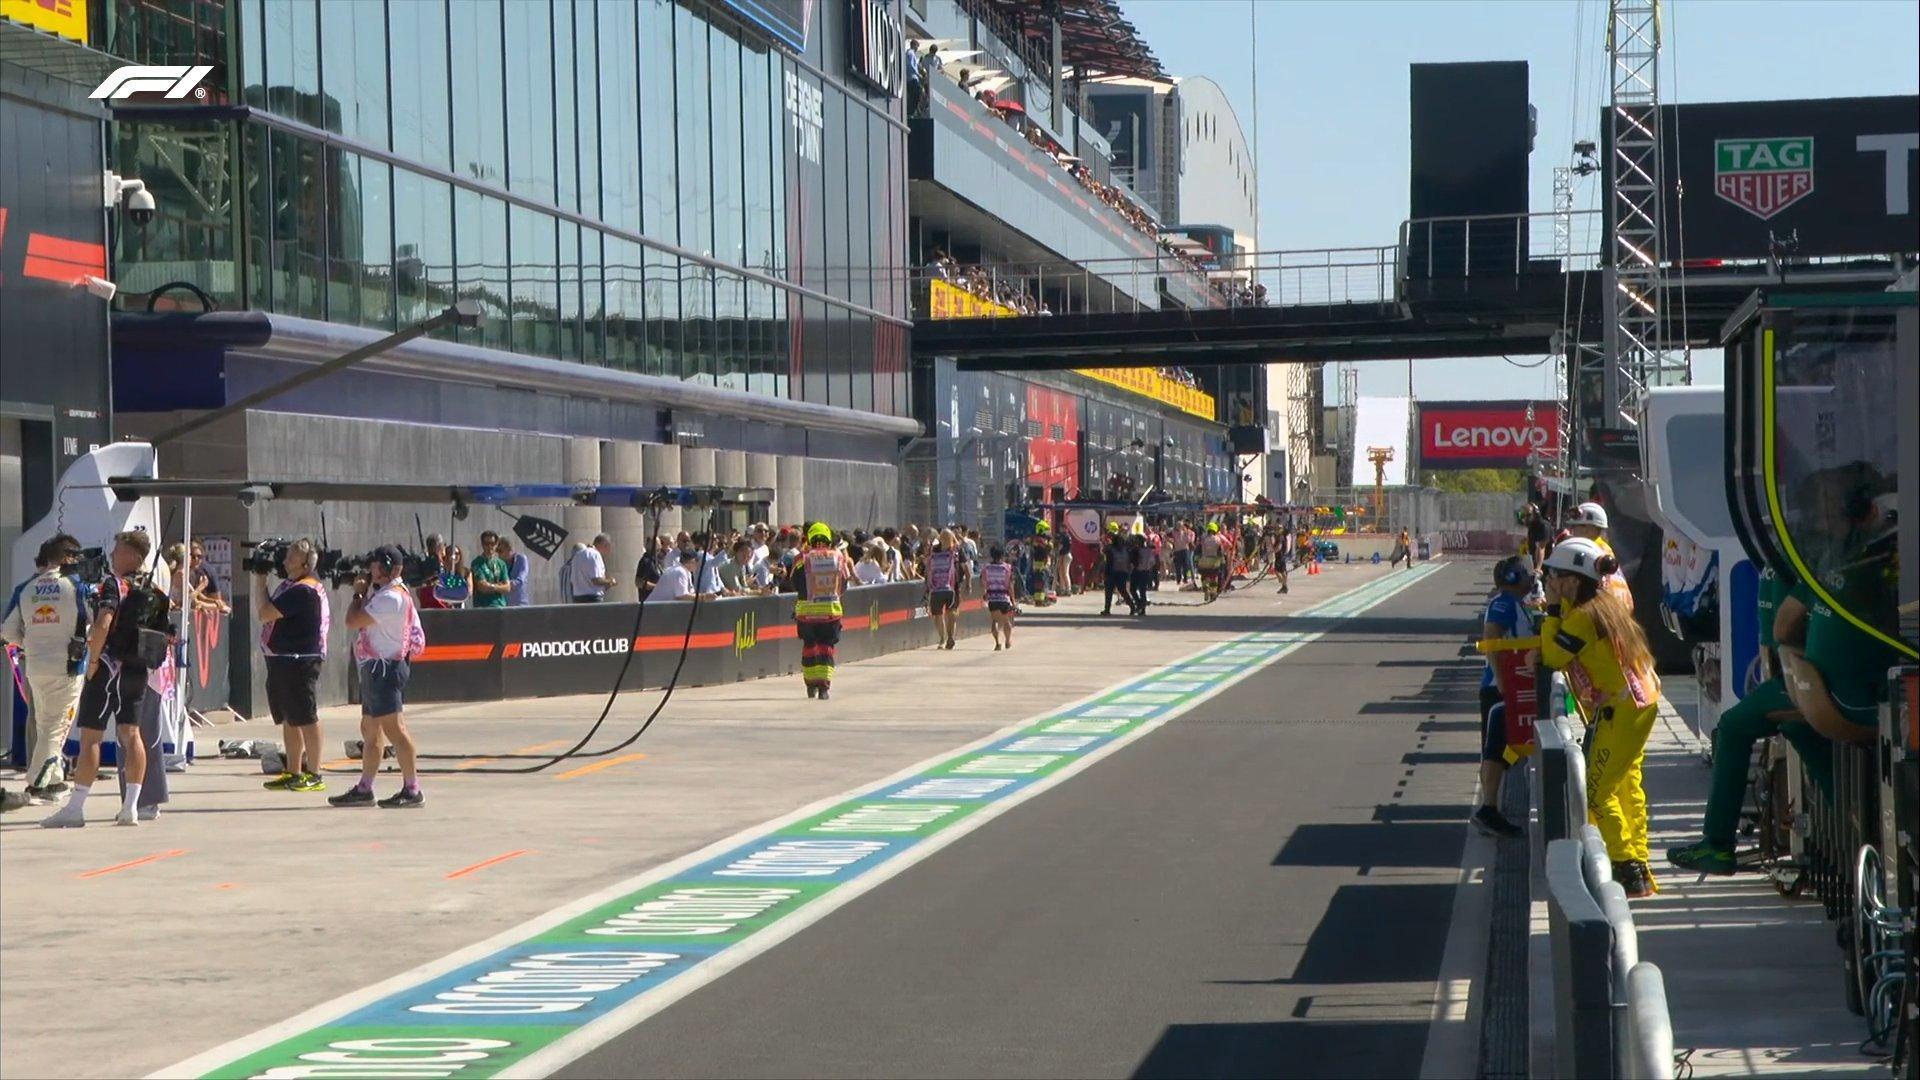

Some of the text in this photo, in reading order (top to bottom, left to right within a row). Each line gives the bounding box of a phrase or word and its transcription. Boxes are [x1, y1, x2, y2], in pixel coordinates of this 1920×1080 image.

[1723, 142, 1804, 169] TAG
[1720, 174, 1808, 214] HEUER
[1434, 422, 1549, 448] Lenovo
[35, 584, 60, 594] VISA
[522, 640, 591, 658] PADDOCK
[593, 638, 629, 654] CLUB
[583, 888, 802, 936] aramco
[407, 951, 682, 1015] aramco
